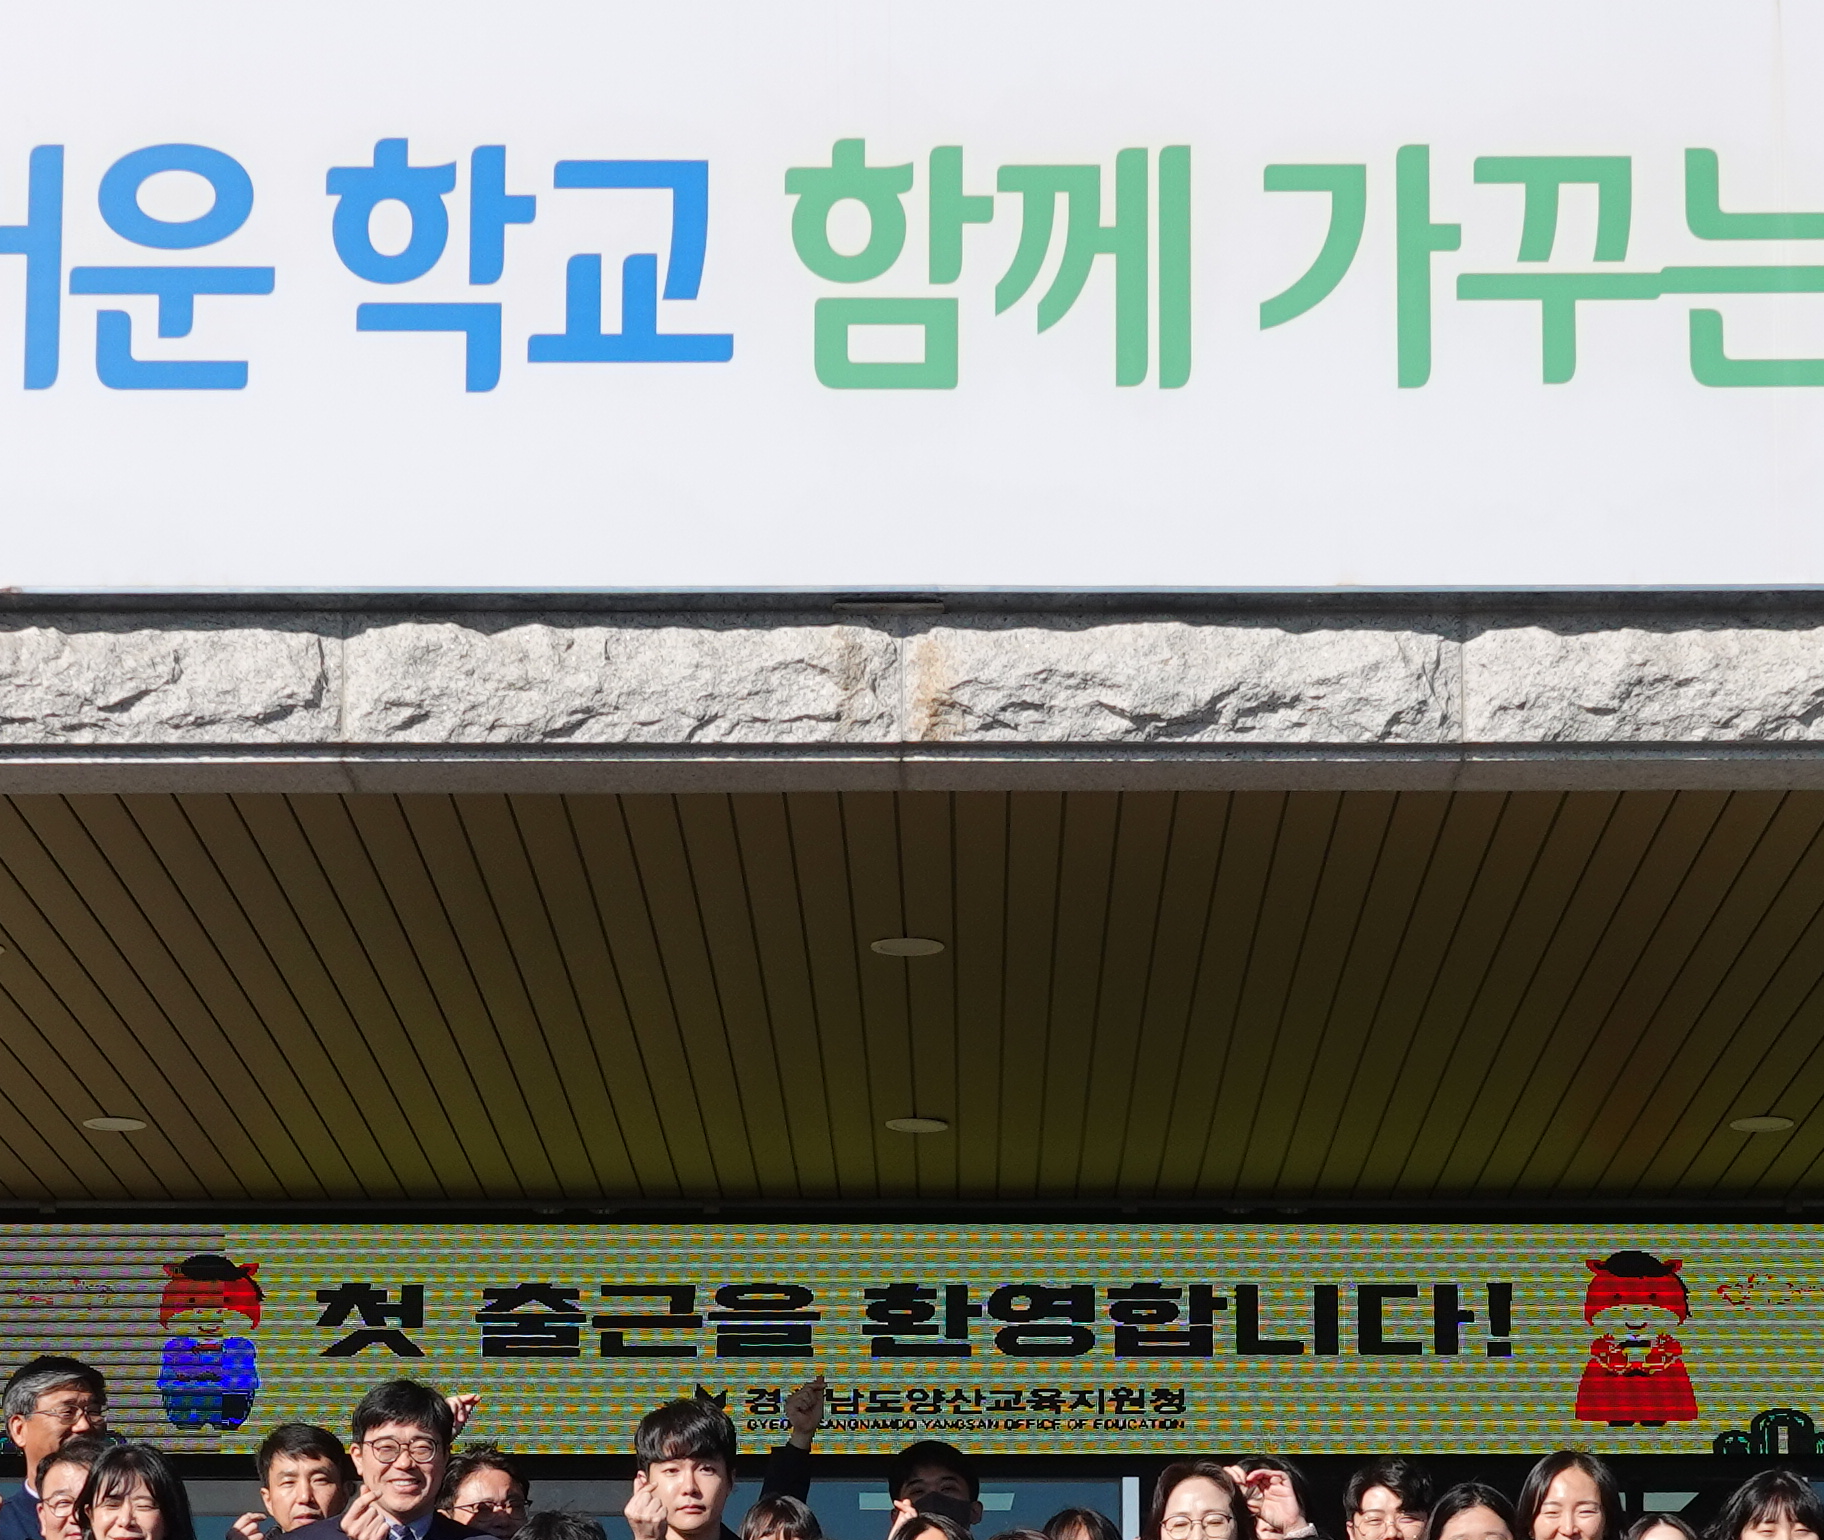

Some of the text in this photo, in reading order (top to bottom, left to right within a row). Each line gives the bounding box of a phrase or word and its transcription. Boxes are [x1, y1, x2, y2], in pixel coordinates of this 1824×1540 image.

[326, 137, 735, 393] 학교
[785, 138, 1191, 389] 함께
[316, 1282, 1513, 1357] 첫 출근을 환영합니다!
[746, 1387, 1186, 1415] 경남도양산교육지원청
[1067, 1418, 1087, 1431] OF
